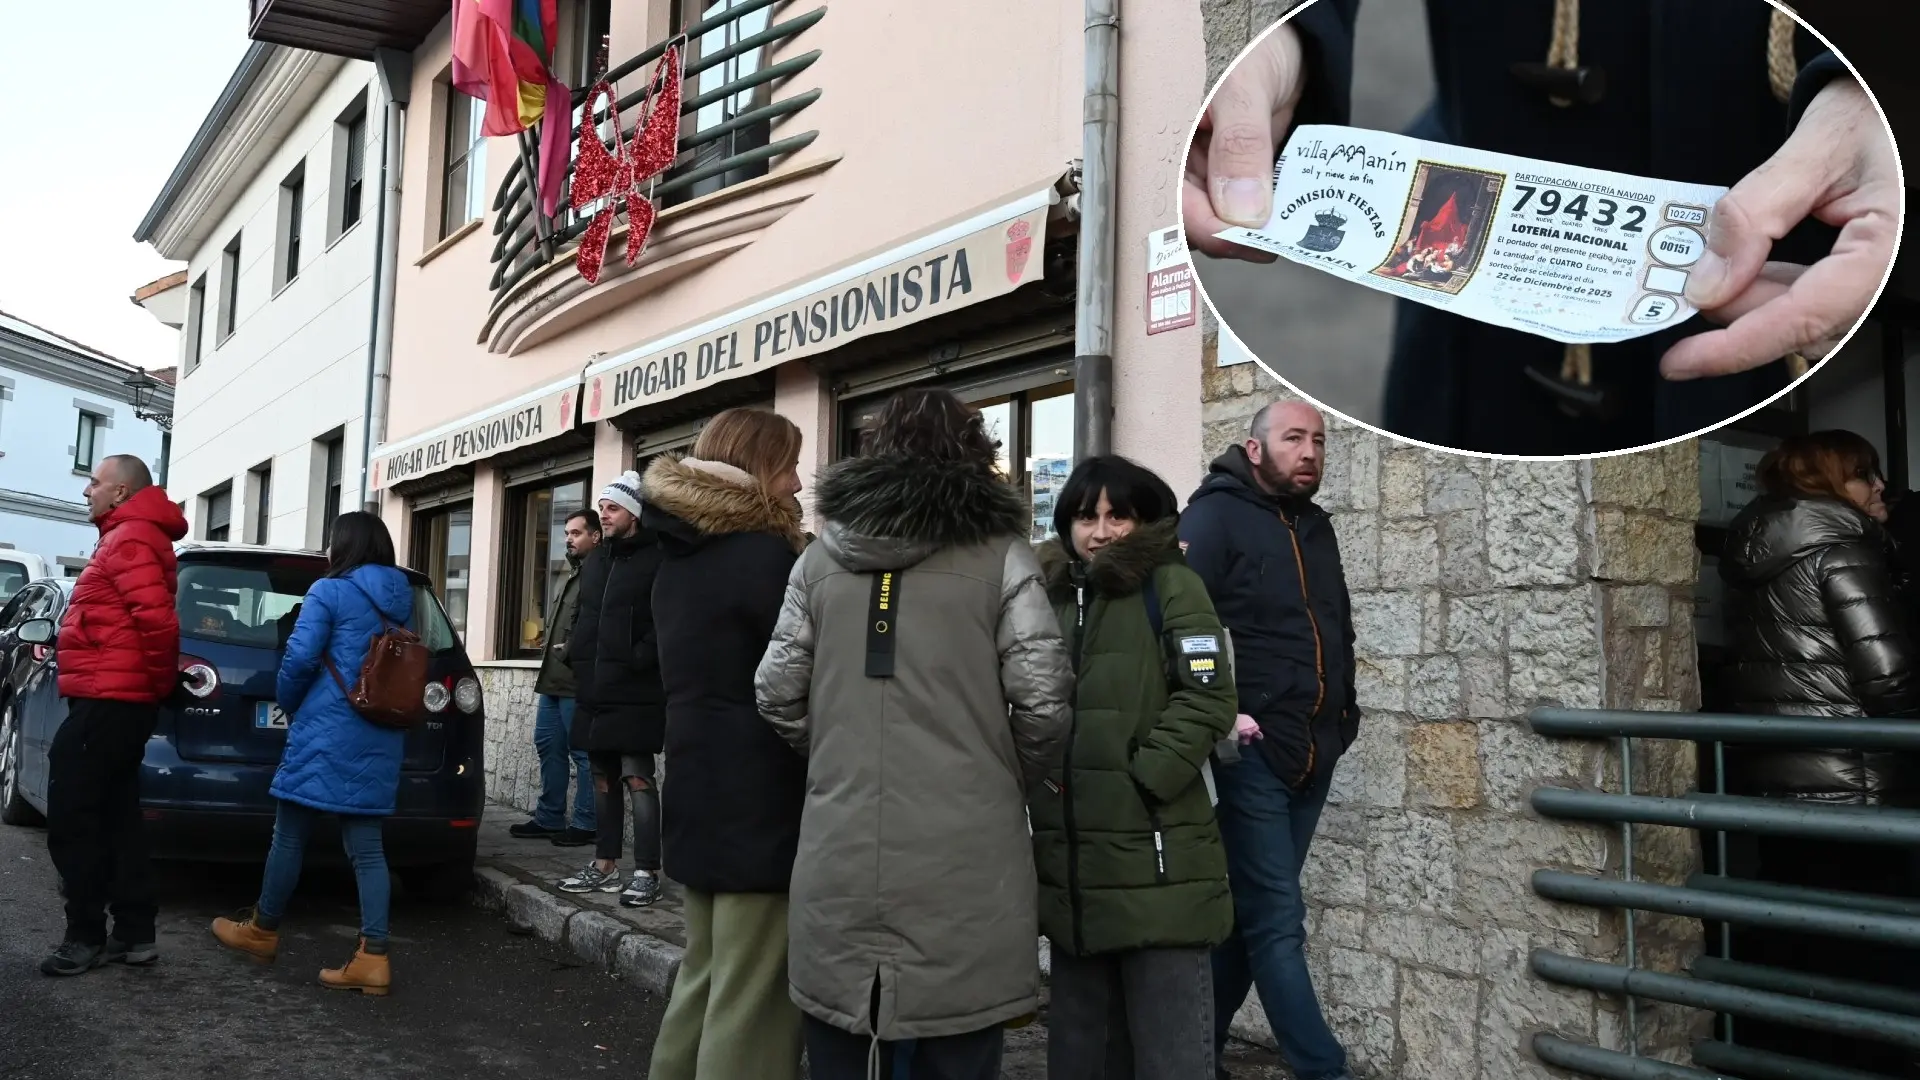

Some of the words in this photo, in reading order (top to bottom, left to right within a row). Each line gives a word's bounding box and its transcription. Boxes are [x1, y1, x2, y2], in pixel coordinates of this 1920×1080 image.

[1302, 165, 1314, 175] sol
[1316, 170, 1321, 179] y
[1325, 169, 1345, 180] nieve
[1349, 172, 1360, 181] sin
[1362, 173, 1374, 185] fin
[1515, 172, 1579, 188] PARTICIPACIÓN
[1580, 182, 1615, 195] LOTERÍA
[1617, 189, 1656, 203] NAVIDAD
[1280, 185, 1345, 220] COMISIÓN
[1346, 192, 1386, 239] FIESTAS
[1512, 184, 1647, 233] 79432
[1536, 216, 1554, 224] NUEVE
[1670, 209, 1702, 221] 102/25
[1497, 235, 1505, 243] El
[1506, 238, 1538, 249] portador
[1540, 242, 1552, 251] del
[1553, 245, 1587, 256] presente
[1588, 252, 1614, 262] recibo
[1614, 255, 1637, 266] juega
[1511, 223, 1560, 239] LOTERÍA
[1563, 231, 1629, 252] NACIONAL
[1660, 240, 1691, 255] 00151
[1489, 261, 1513, 270] sorteo
[1513, 265, 1528, 274] que
[1493, 248, 1500, 256] la
[1503, 250, 1535, 261] cantidad
[1549, 257, 1583, 269] CUATRO
[1625, 269, 1633, 277] el
[1151, 267, 1191, 289] Alarma
[1496, 272, 1509, 280] 22
[1509, 275, 1522, 283] de
[1523, 276, 1573, 292] Diciembre
[1573, 286, 1587, 294] de
[1587, 287, 1613, 298] 2025
[1645, 305, 1663, 318] 5
[613, 350, 688, 407] HOGAR
[696, 331, 744, 381] DEL
[753, 247, 973, 363] PENSIONISTA
[386, 447, 423, 481] HOGAR
[426, 438, 448, 471] DEL
[451, 404, 543, 461] PENSIONISTA
[879, 572, 892, 610] BELONG
[184, 707, 221, 716] GOLF
